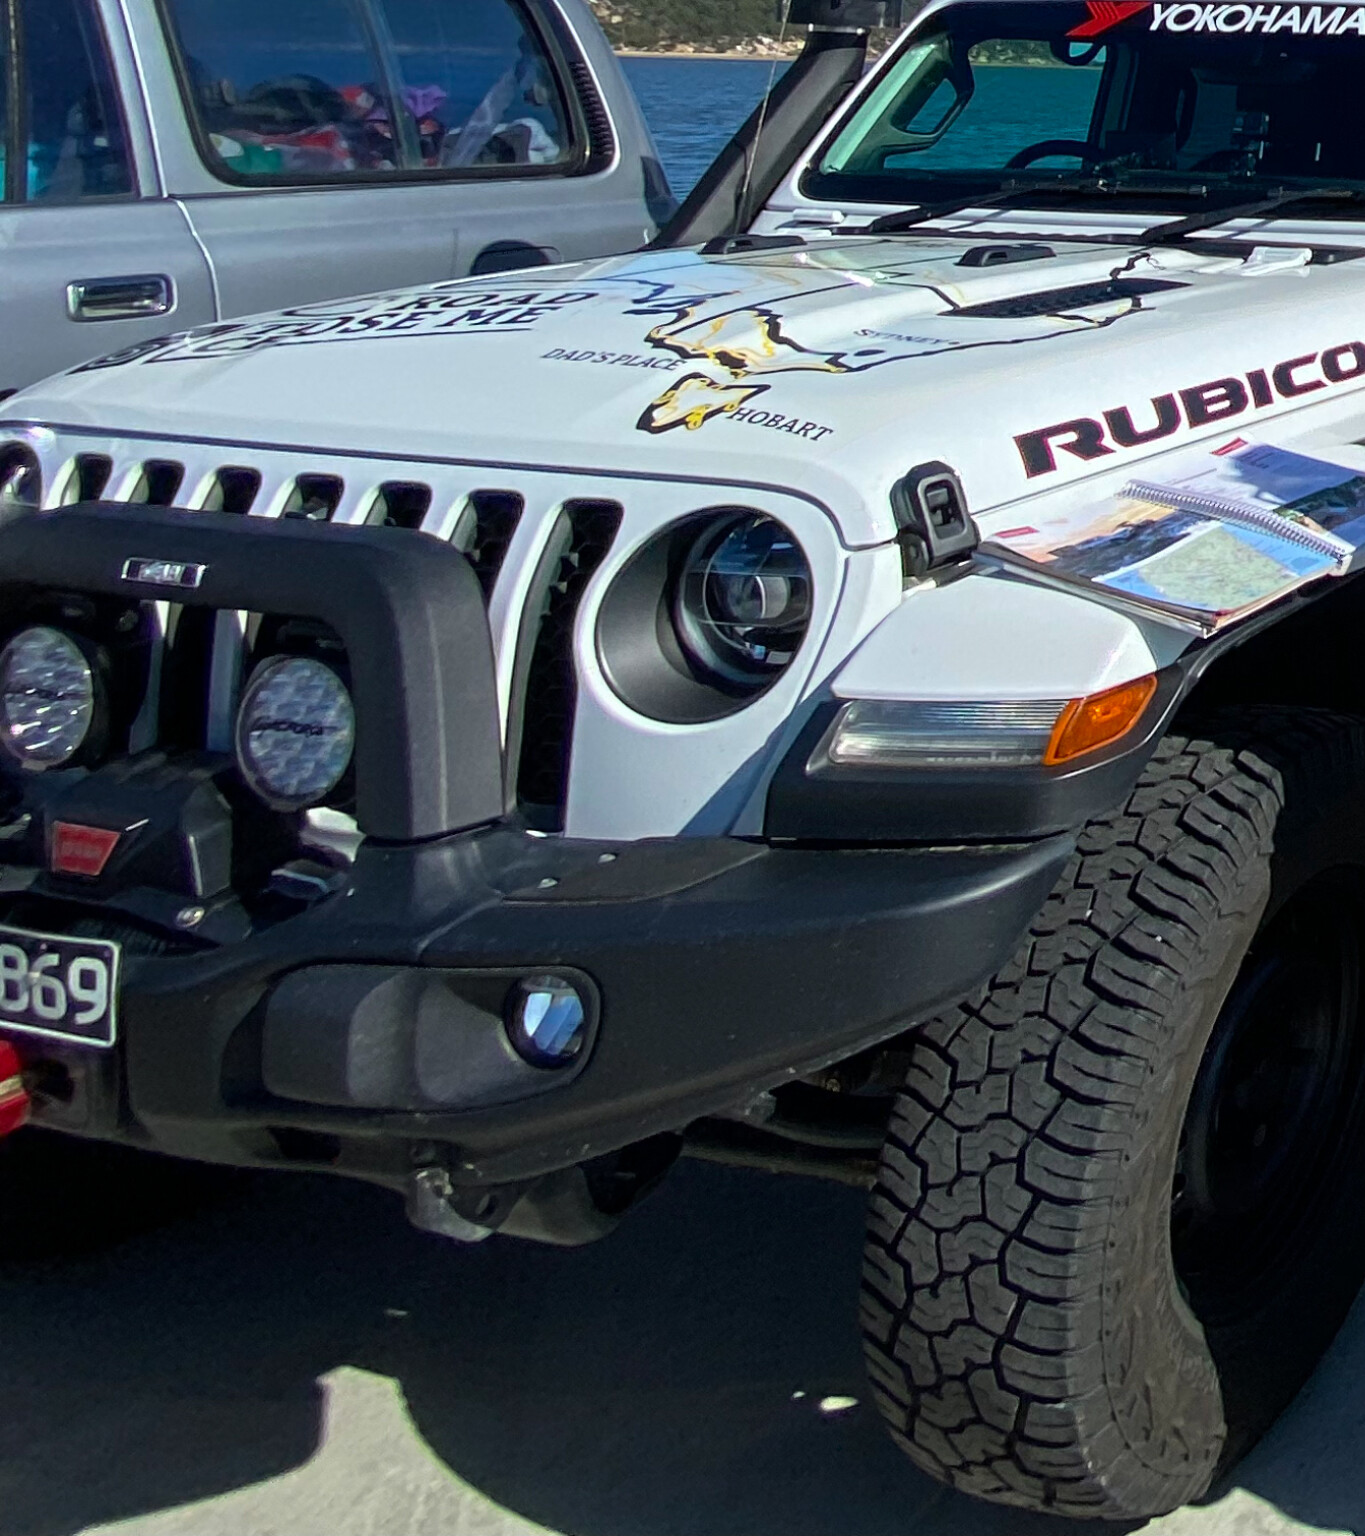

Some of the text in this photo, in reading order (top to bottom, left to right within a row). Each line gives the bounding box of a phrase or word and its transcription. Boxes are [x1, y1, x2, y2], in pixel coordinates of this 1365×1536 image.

[433, 305, 563, 331] ME
[540, 348, 687, 372] DAD'S PLACE
[726, 406, 834, 442] HOBART
